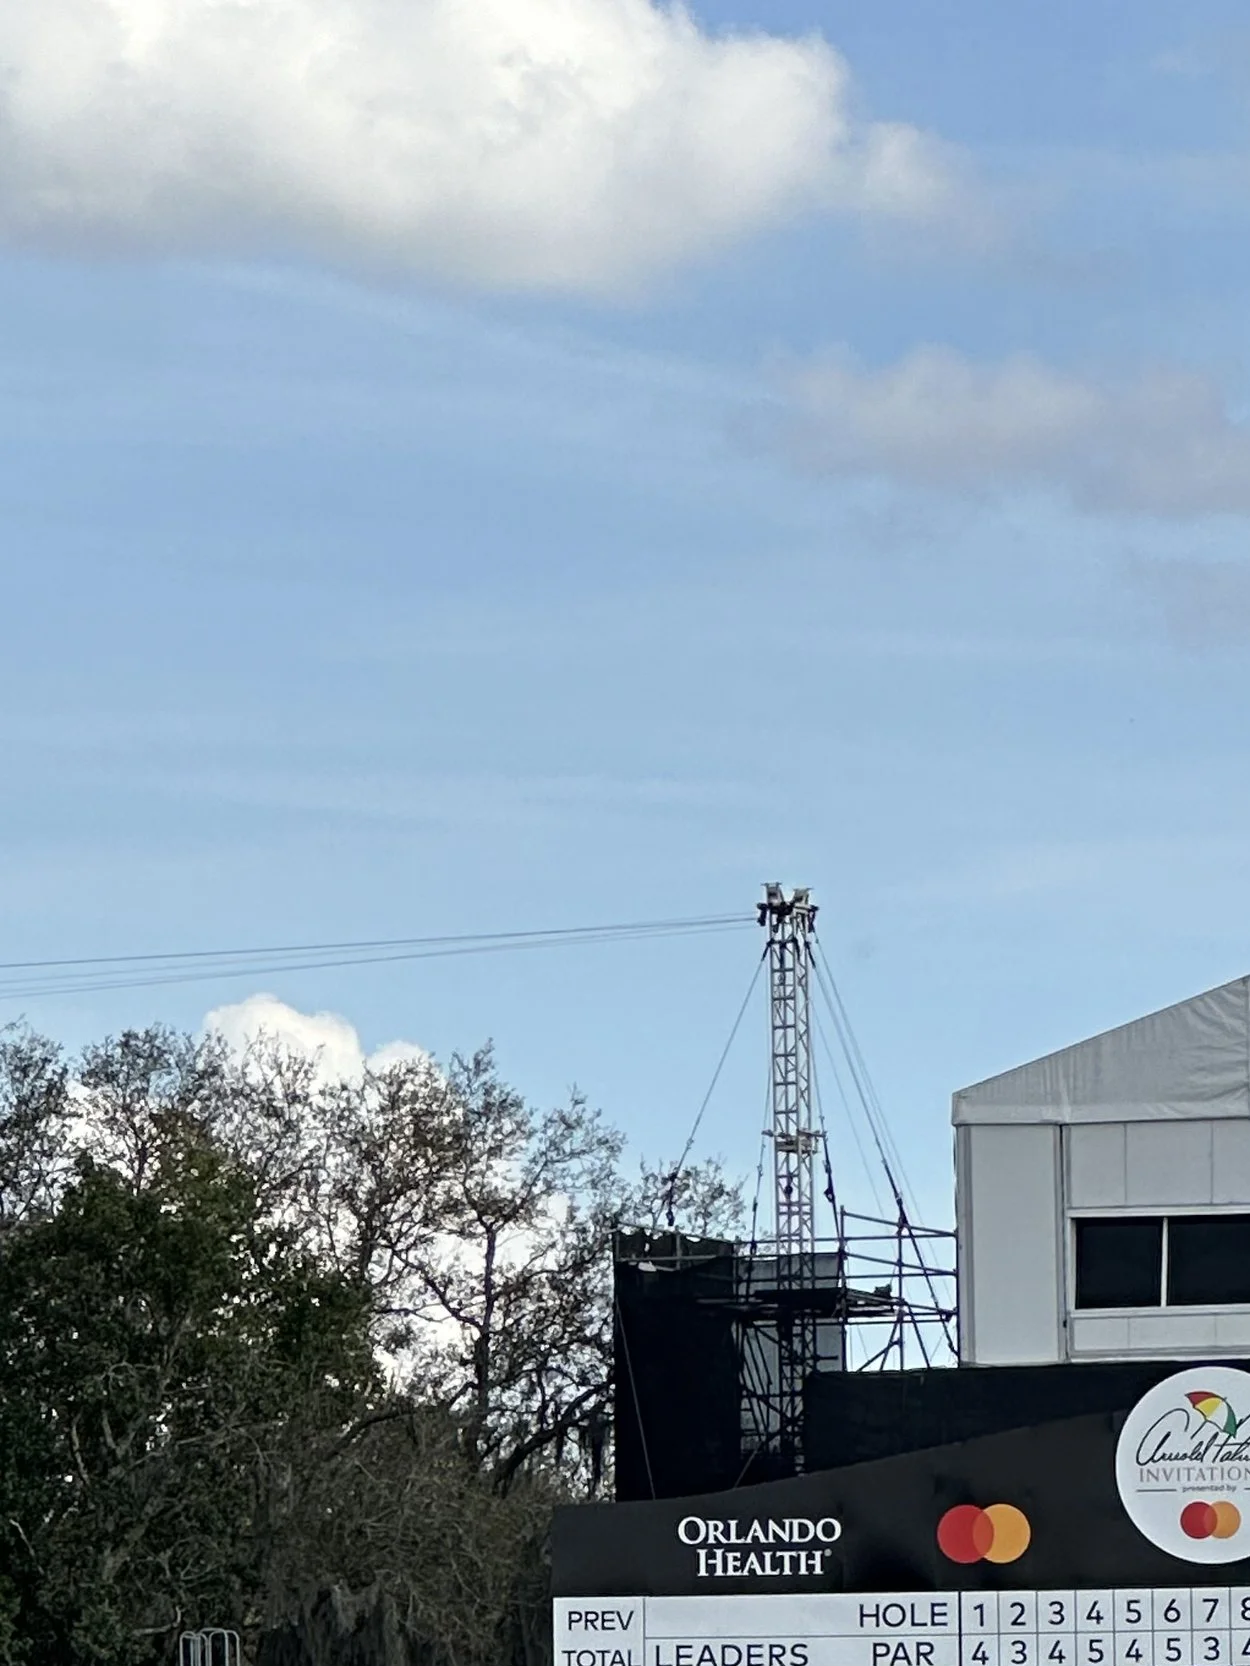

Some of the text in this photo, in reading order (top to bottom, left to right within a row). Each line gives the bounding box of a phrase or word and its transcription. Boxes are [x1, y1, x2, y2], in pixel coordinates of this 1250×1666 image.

[1182, 1484, 1237, 1493] presented by
[678, 1517, 841, 1544] ORLANDO
[697, 1549, 823, 1576] HEALTH
[569, 1611, 633, 1630] PREV
[860, 1603, 947, 1627] HOLE
[974, 1604, 984, 1626] 1
[1011, 1602, 1026, 1625] 2
[1049, 1601, 1064, 1625] 3
[1086, 1601, 1103, 1624] 4
[1126, 1600, 1141, 1623] 5
[1164, 1599, 1180, 1622] 6
[1203, 1599, 1218, 1622] 7
[873, 1642, 934, 1666] PAR
[972, 1642, 988, 1665] 4
[1012, 1641, 1026, 1664] 3
[1049, 1640, 1065, 1663] 4
[1089, 1640, 1103, 1663] 5
[1126, 1639, 1142, 1662] 4
[1166, 1638, 1181, 1661] 5
[1204, 1637, 1219, 1660] 3
